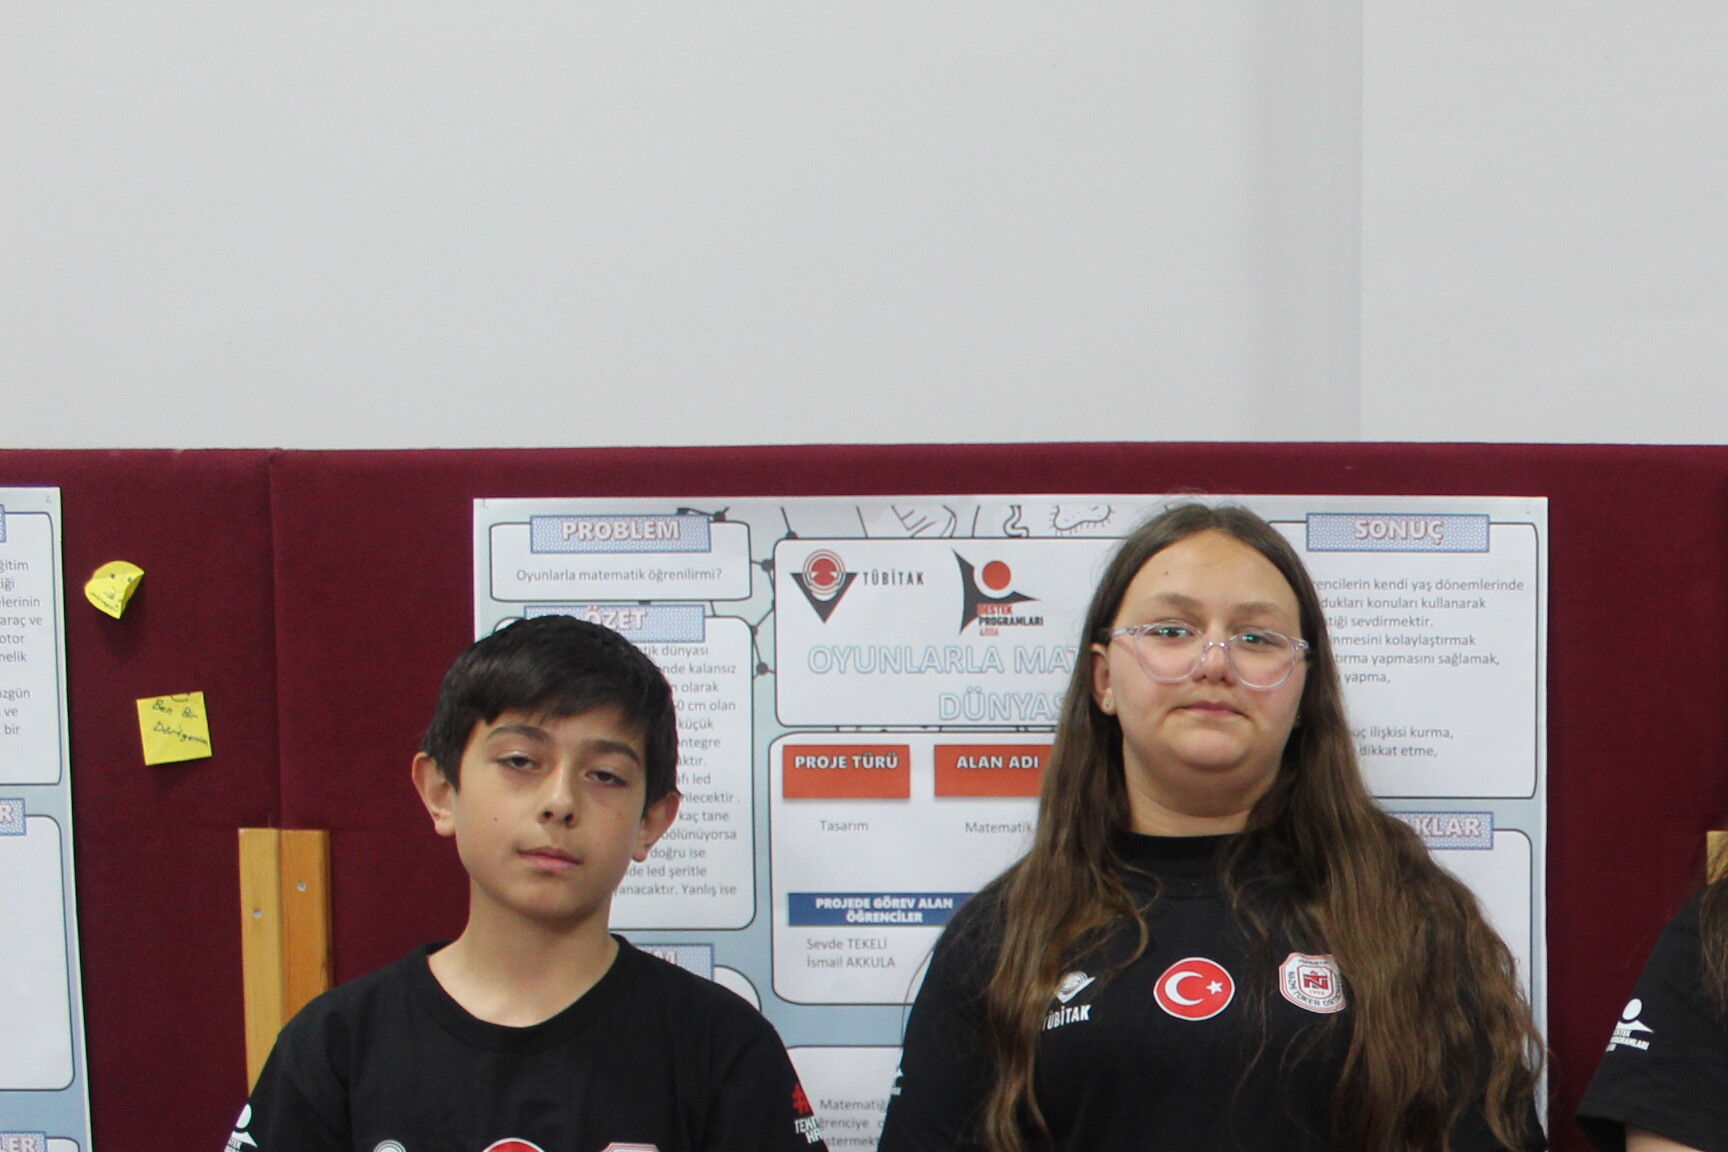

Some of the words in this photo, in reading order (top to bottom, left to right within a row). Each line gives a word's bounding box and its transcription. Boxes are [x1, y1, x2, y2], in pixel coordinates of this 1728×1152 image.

[562, 520, 681, 542] PROBLEM
[1354, 519, 1444, 546] SONUÇ
[516, 568, 576, 583] Oyunlarla
[579, 568, 646, 581] matematik
[650, 568, 722, 583] öğrenilirmi?
[862, 568, 925, 586] TÜBİTAK
[1374, 578, 1408, 591] kendi
[1411, 580, 1432, 593] yaş
[1435, 579, 1525, 592] dönemlerinde
[1421, 597, 1486, 610] kullanarak
[30, 616, 43, 626] ve
[583, 604, 648, 631] ÖZET
[1350, 615, 1433, 628] sevdirmektir.
[1385, 633, 1476, 648] kolaylaştırmak
[661, 645, 709, 658] dünyası
[807, 645, 1005, 674] OYUNLARLA
[1371, 654, 1435, 667] yapmasını
[1438, 652, 1500, 667] sağlamak,
[688, 663, 737, 674] kalansız
[1344, 673, 1391, 684] yapma,
[681, 681, 719, 692] olarak
[4, 708, 18, 717] ve
[709, 701, 737, 711] olan
[4, 723, 20, 735] bir
[678, 719, 714, 732] küçük
[1369, 726, 1408, 739] ilişkisi
[1410, 726, 1454, 740] kurma,
[1359, 745, 1398, 757] dikkat
[1400, 746, 1438, 759] etme,
[794, 756, 848, 769] PROJE
[852, 753, 898, 769] TÜRÜ
[956, 756, 1005, 769] ALAN
[1009, 756, 1039, 769] ADI
[691, 774, 711, 785] led
[678, 811, 698, 824] kaç
[702, 812, 730, 822] tane
[819, 820, 870, 832] Tasarım
[964, 822, 1033, 834] Matematik
[650, 847, 686, 860] doğru
[688, 847, 706, 858] ise
[646, 866, 666, 877] led
[669, 866, 708, 879] şeritle
[681, 884, 717, 898] Yanlış
[719, 885, 737, 896] ise
[815, 897, 872, 909] PROJEDE
[874, 895, 916, 909] GÖREV
[917, 897, 953, 909] ALAN
[846, 908, 924, 924] ÖĞRENCİLER
[806, 939, 845, 950] Sevde
[847, 937, 888, 950] TEKELİ
[806, 956, 843, 969] İsmail
[845, 957, 896, 969] AKKULA
